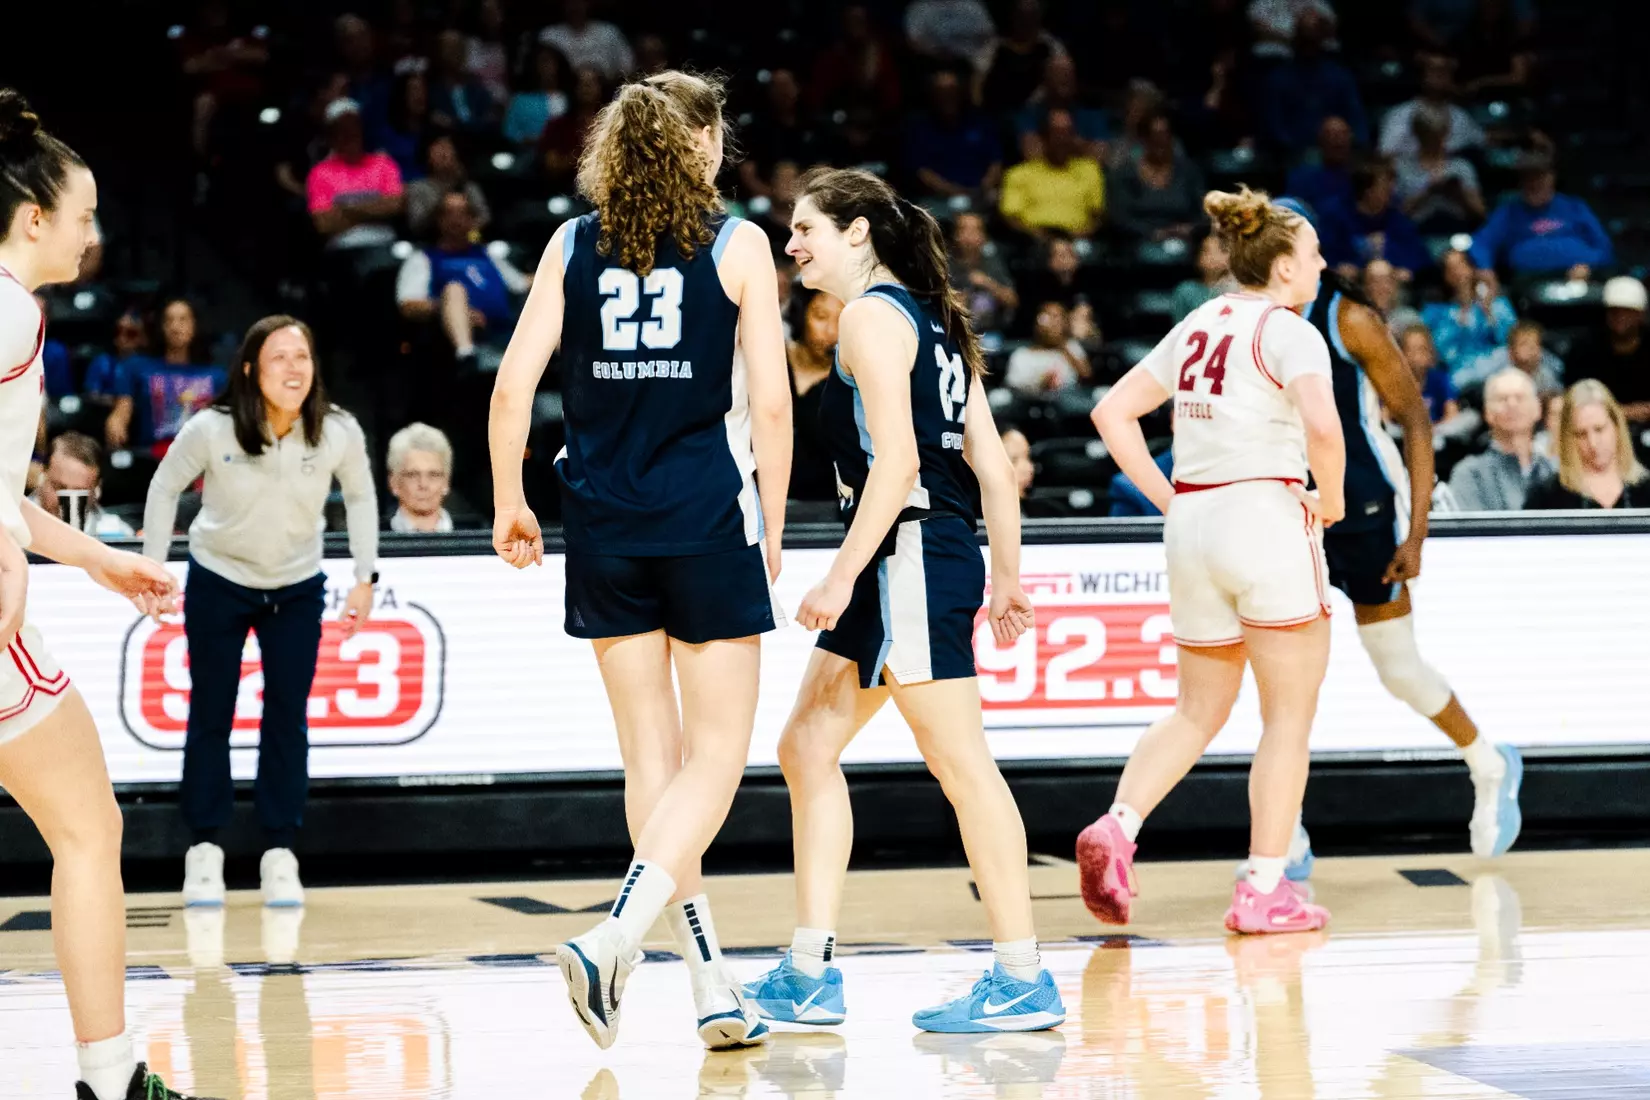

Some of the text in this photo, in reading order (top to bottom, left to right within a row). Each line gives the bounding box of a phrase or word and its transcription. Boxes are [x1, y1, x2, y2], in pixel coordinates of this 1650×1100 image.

[597, 267, 685, 351] 23
[592, 360, 693, 380] COLUMBIA
[1178, 329, 1235, 396] 24
[1178, 401, 1214, 420] STEELE
[974, 614, 1180, 703] 92.3
